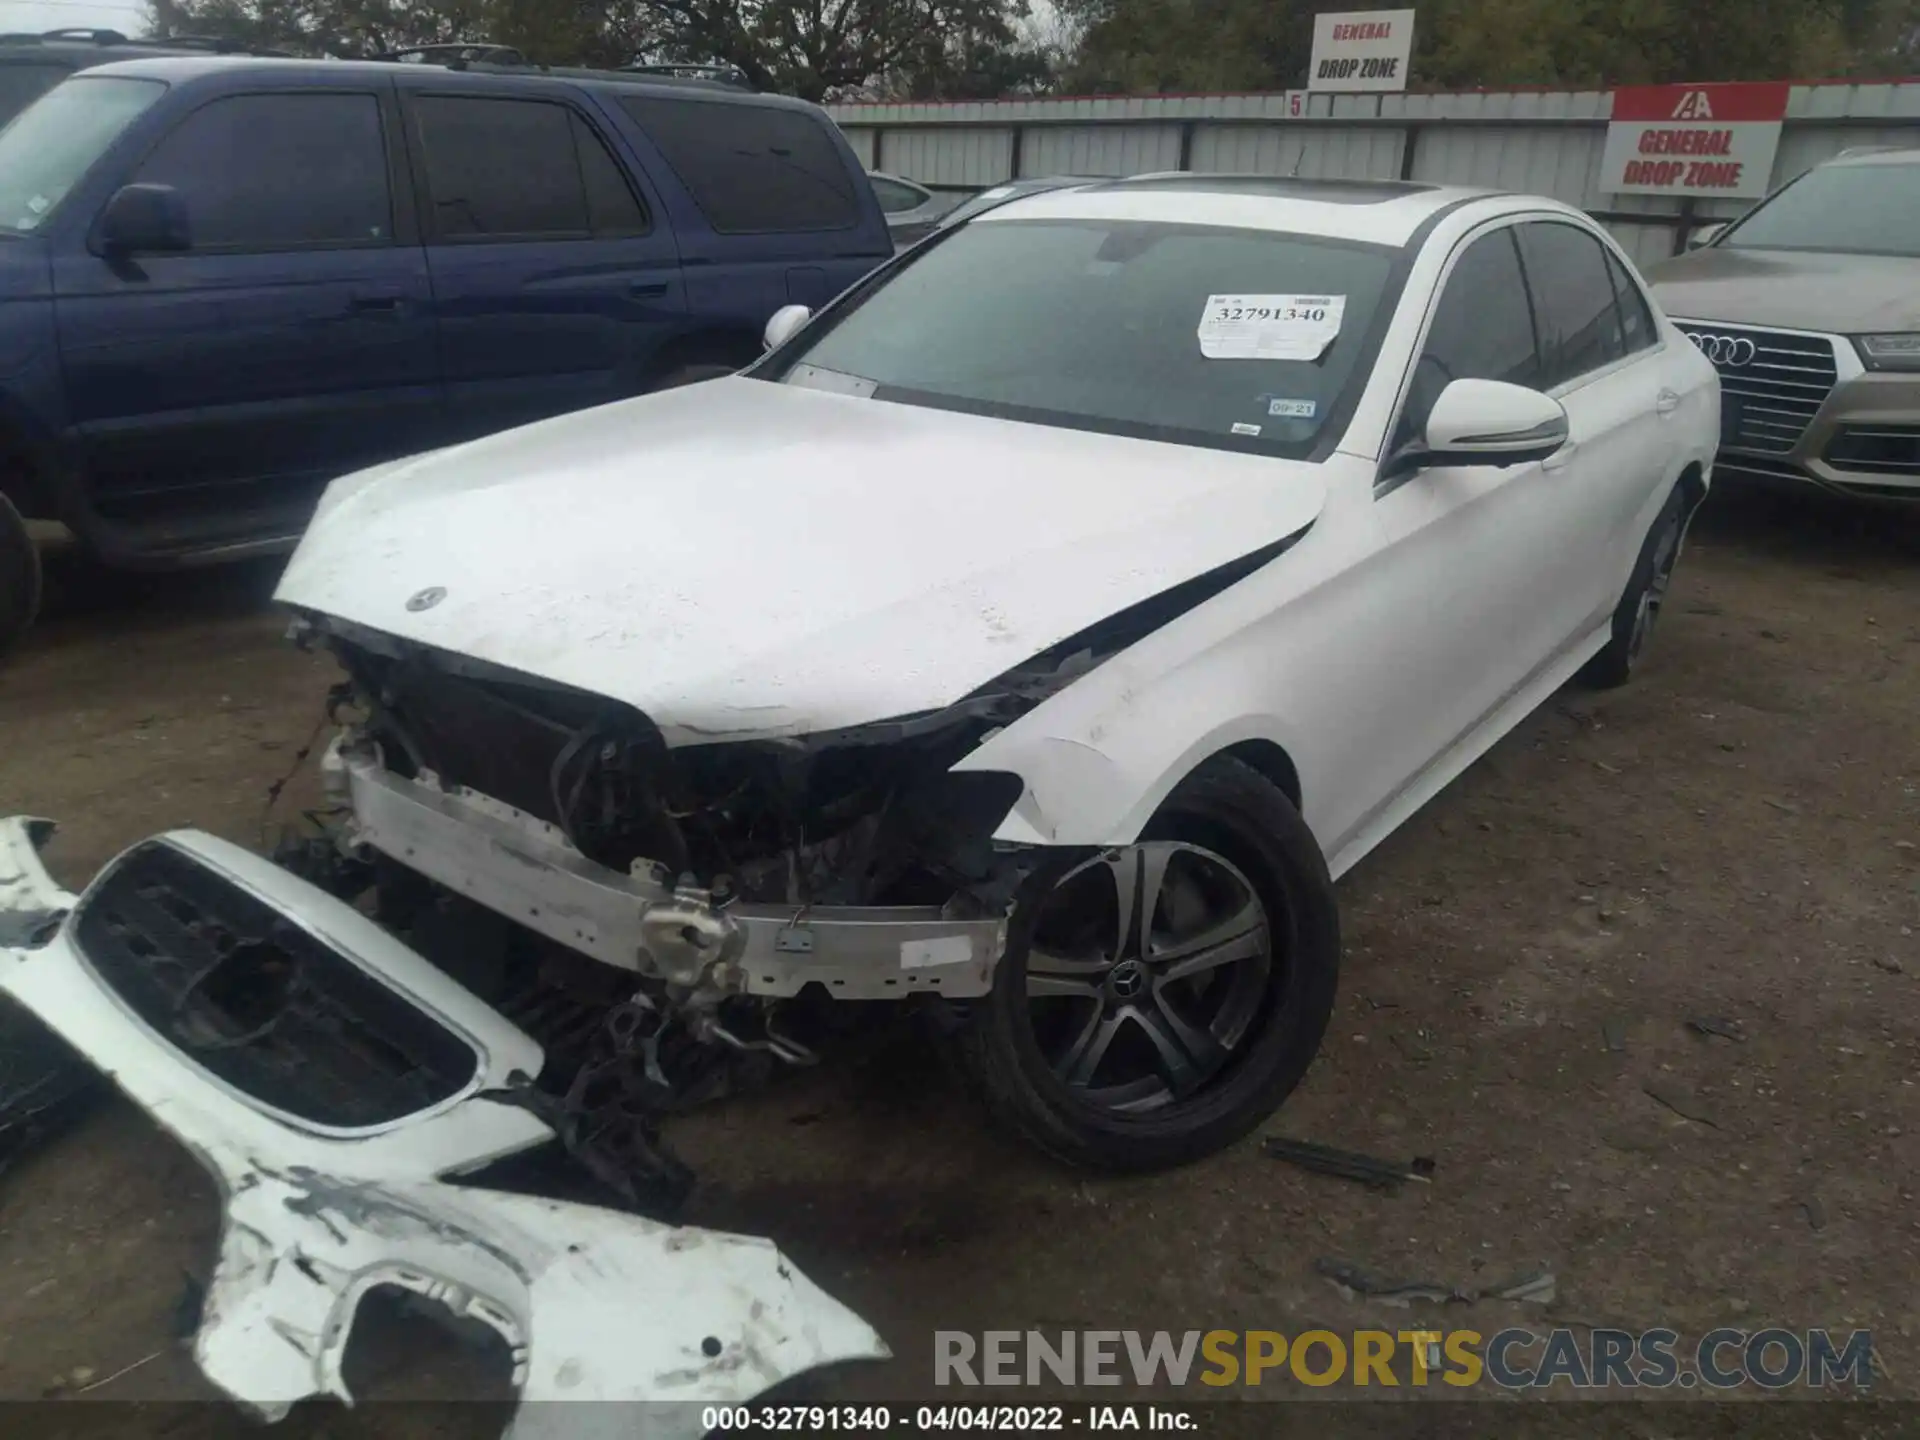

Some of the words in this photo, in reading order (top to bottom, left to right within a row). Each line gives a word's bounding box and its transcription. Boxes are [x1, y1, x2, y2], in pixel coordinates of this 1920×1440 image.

[1332, 22, 1391, 41] GENERAL
[1317, 59, 1358, 79] DROP
[1359, 58, 1398, 78] ZONE
[1291, 94, 1301, 116] 5
[1638, 129, 1733, 156] GENERAL
[1623, 160, 1683, 185] DROP
[1684, 161, 1743, 188] ZONE
[1216, 308, 1325, 321] 32791340
